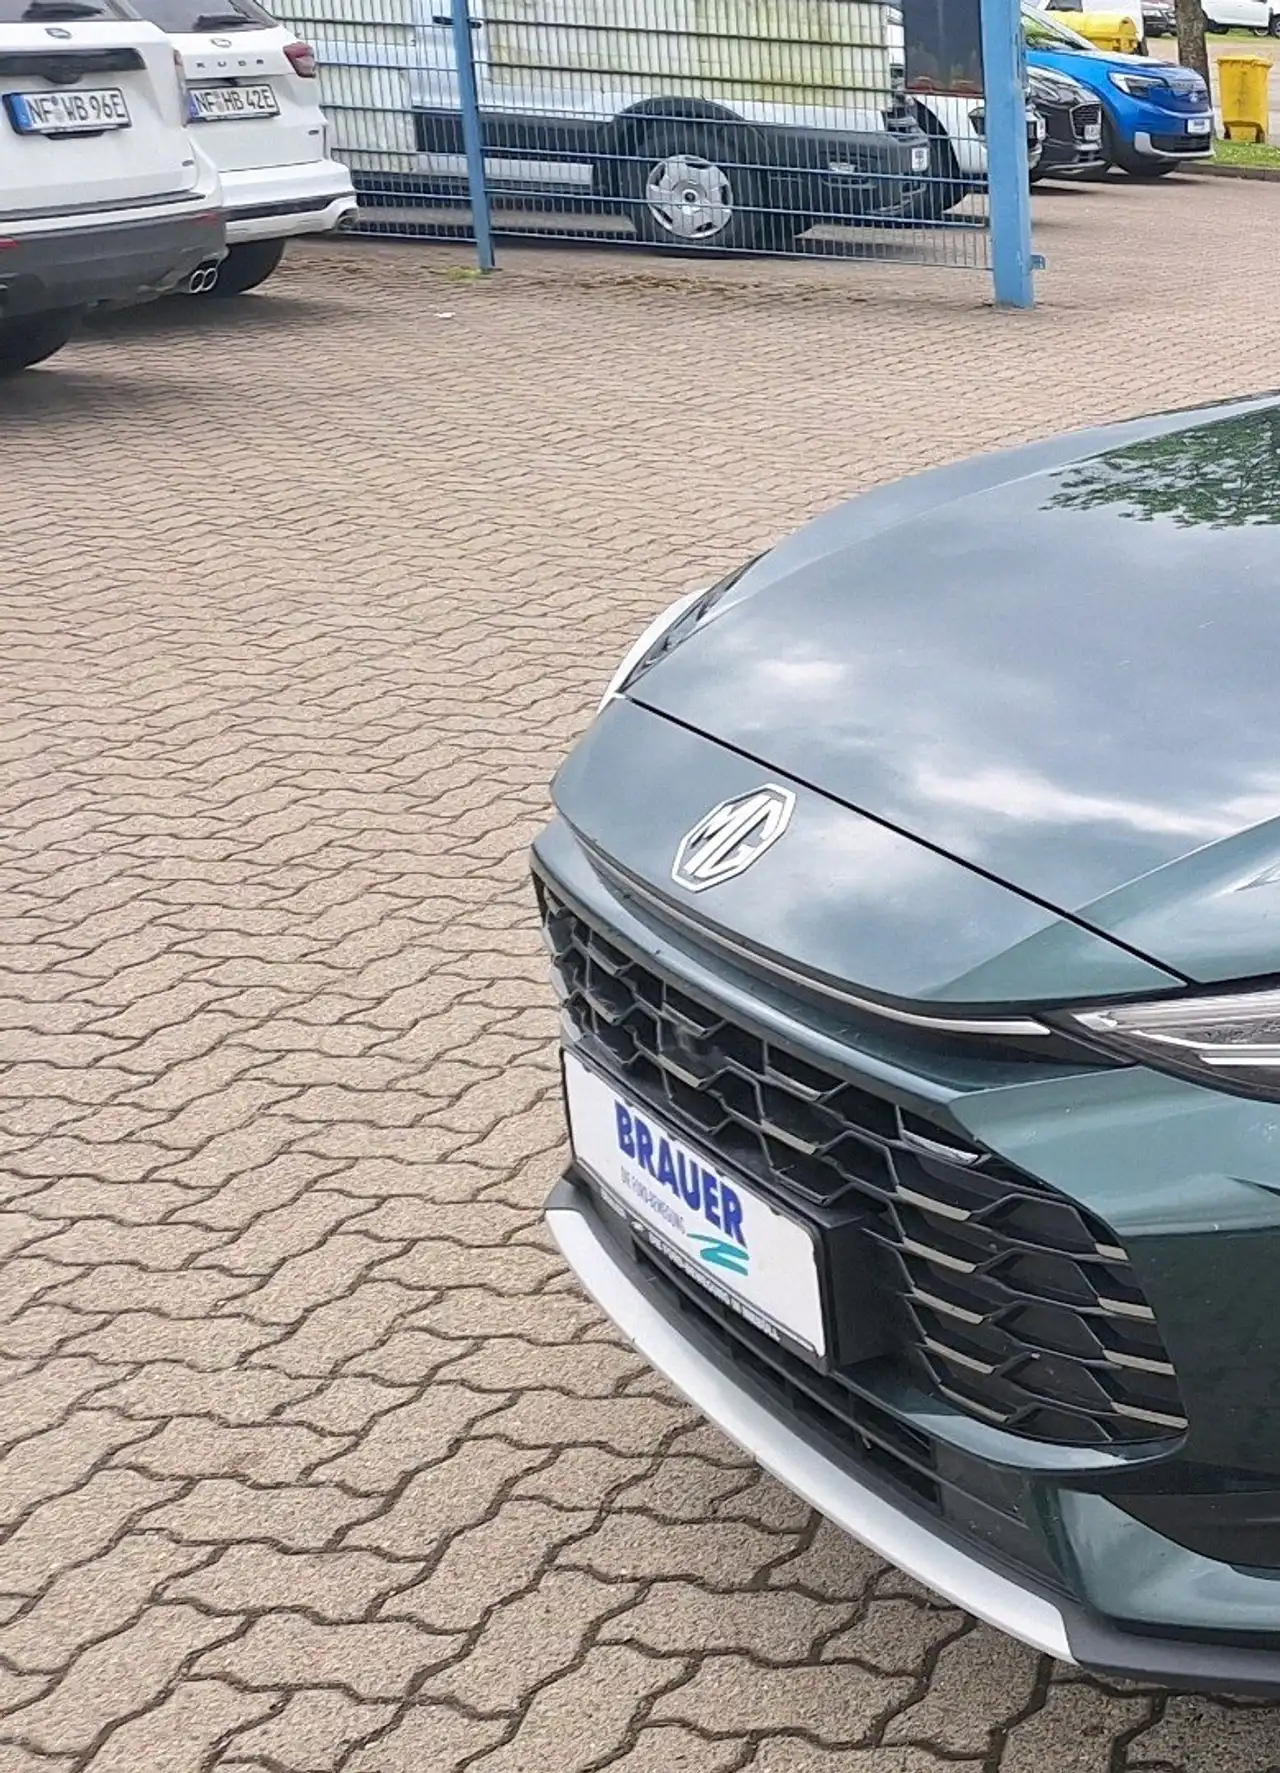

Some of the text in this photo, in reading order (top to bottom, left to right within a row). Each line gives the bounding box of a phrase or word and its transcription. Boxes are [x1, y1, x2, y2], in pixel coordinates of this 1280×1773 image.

[25, 93, 126, 123] NF WB 96E
[194, 87, 276, 113] NF HB 42E
[678, 789, 790, 886] MG
[614, 1099, 748, 1249] BRAUER
